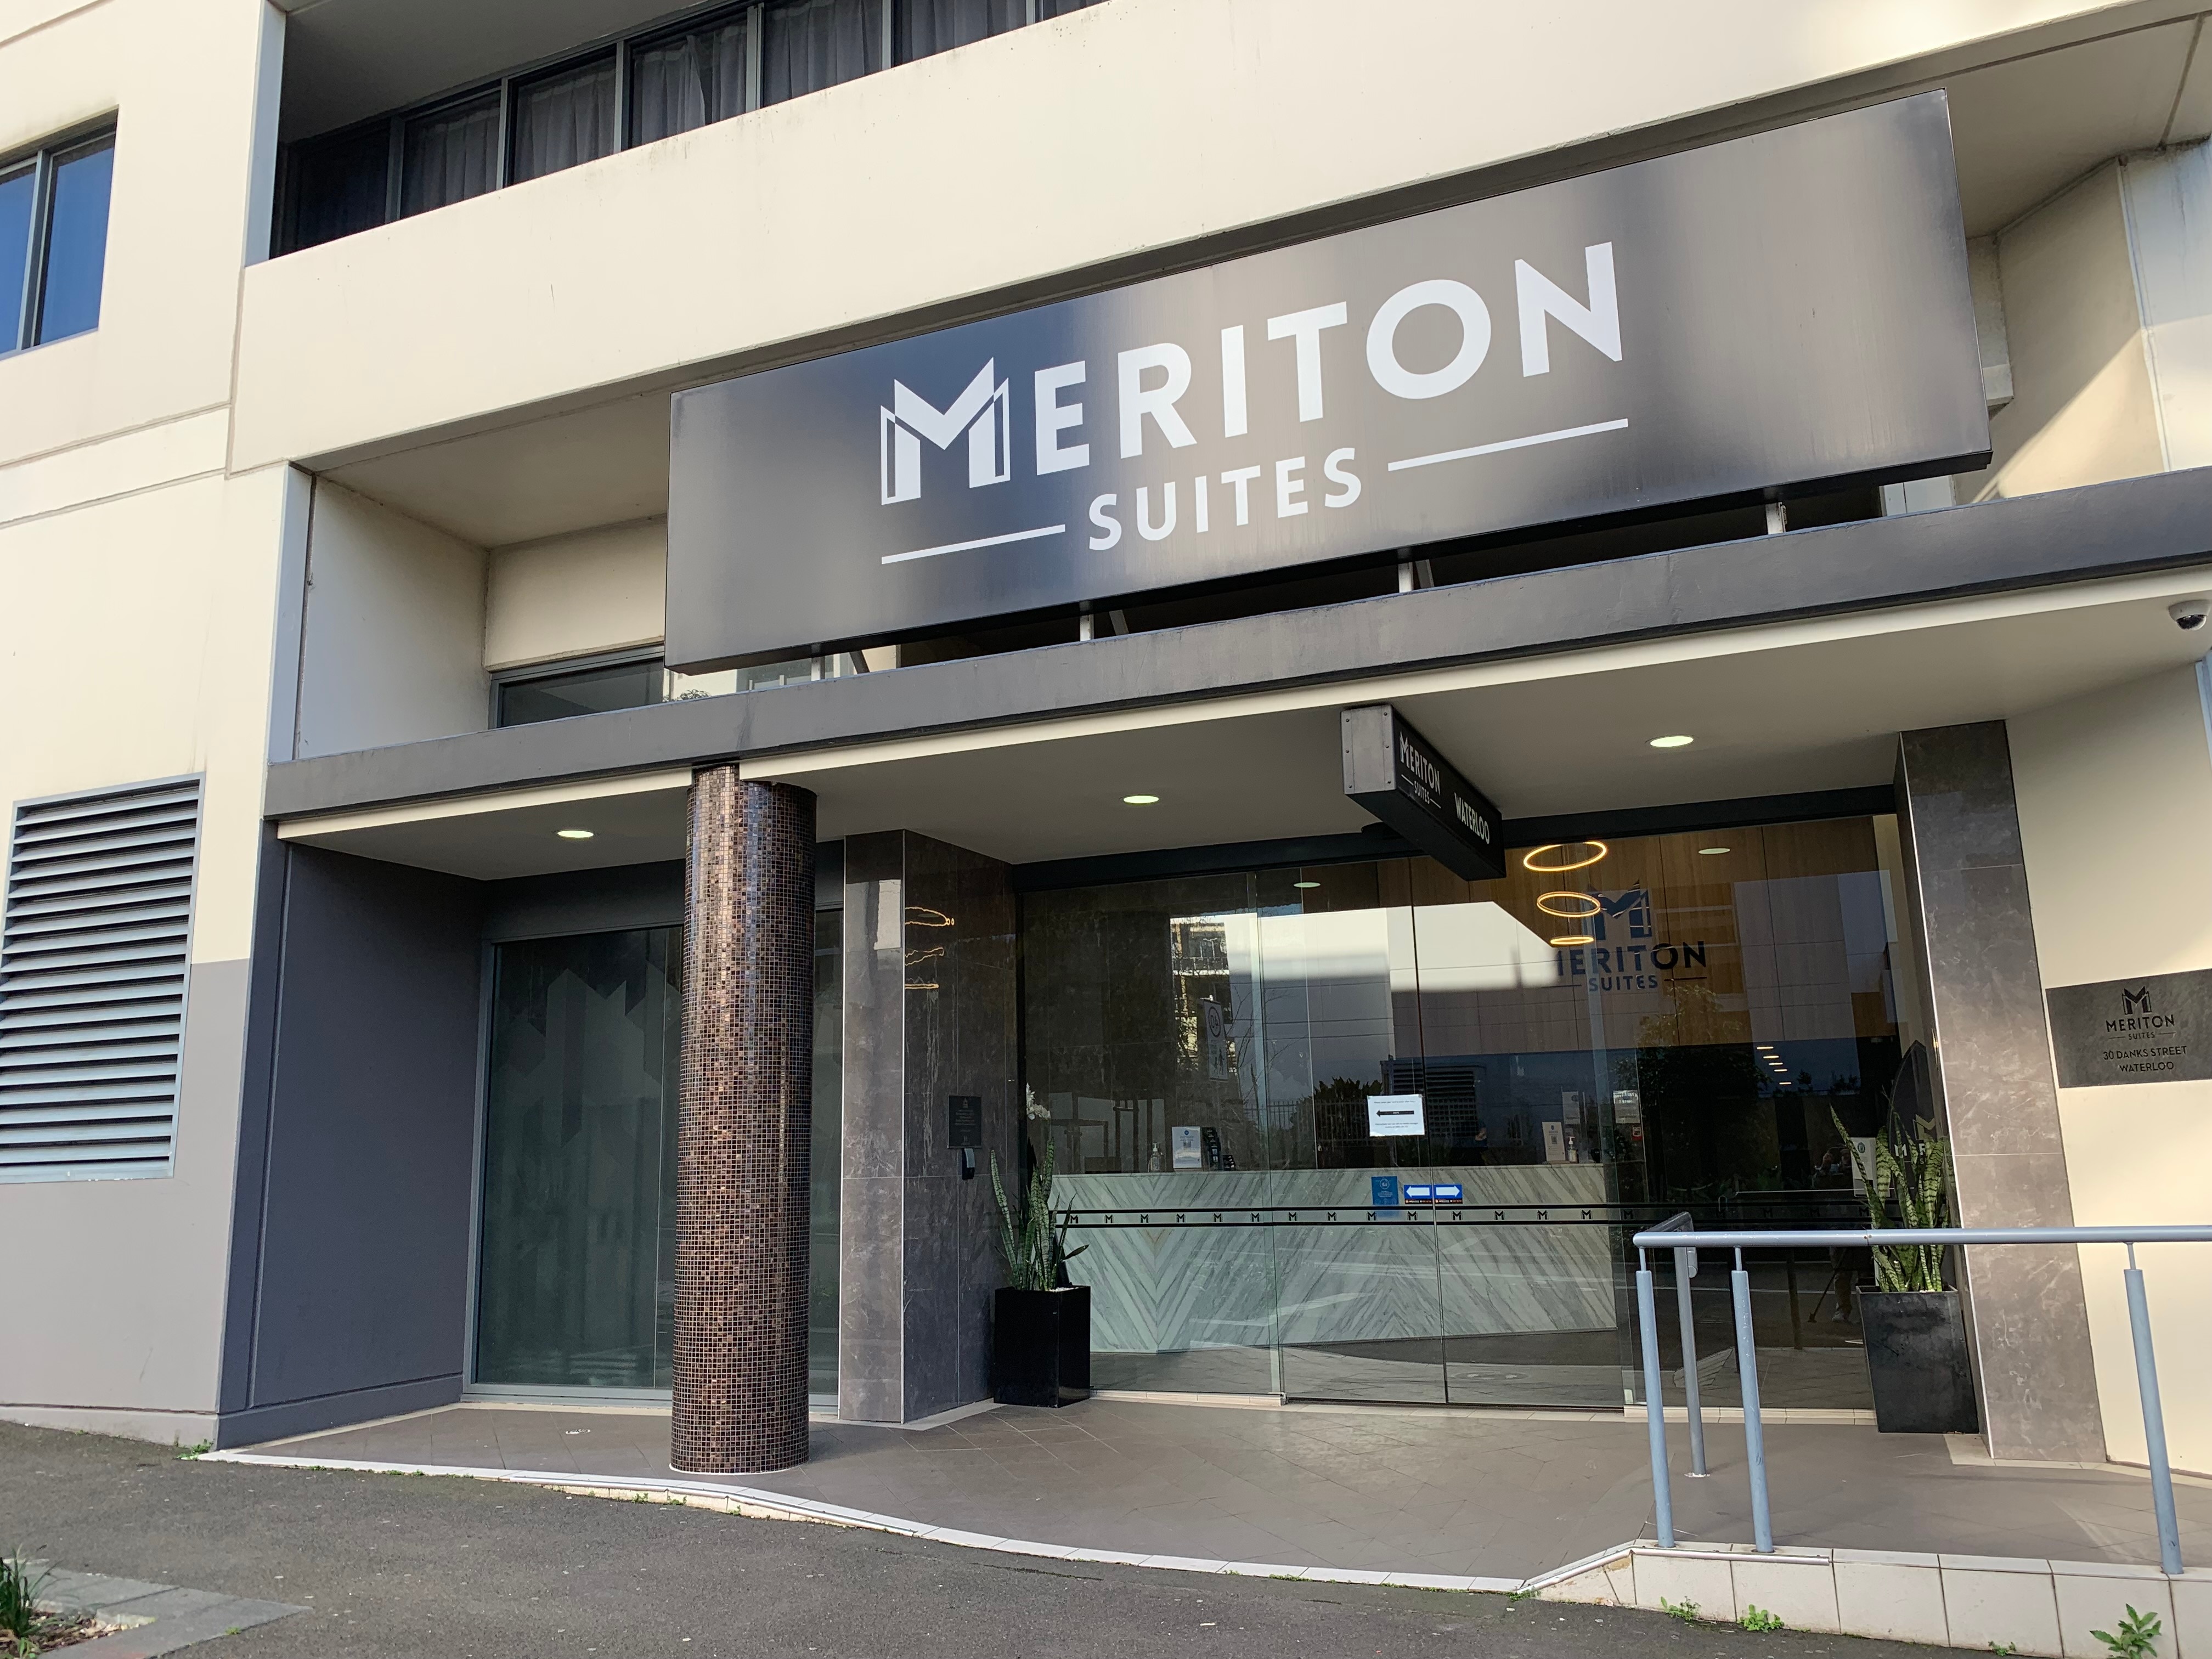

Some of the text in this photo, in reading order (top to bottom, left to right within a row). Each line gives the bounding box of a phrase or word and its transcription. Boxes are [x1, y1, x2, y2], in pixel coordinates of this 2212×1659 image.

[881, 241, 1623, 505] MERITON
[1088, 447, 1361, 551] SUITES
[1400, 731, 1440, 795] MERITON
[1414, 780, 1430, 804] SUITES
[1454, 792, 1490, 845] WATERLOO
[1589, 974, 1658, 992] SUITES
[2106, 1014, 2175, 1032] MERITON
[2128, 1031, 2155, 1040] SUITES
[2103, 1045, 2187, 1060] 30 DANKS STREET
[2119, 1061, 2174, 1072] WATERLOO
